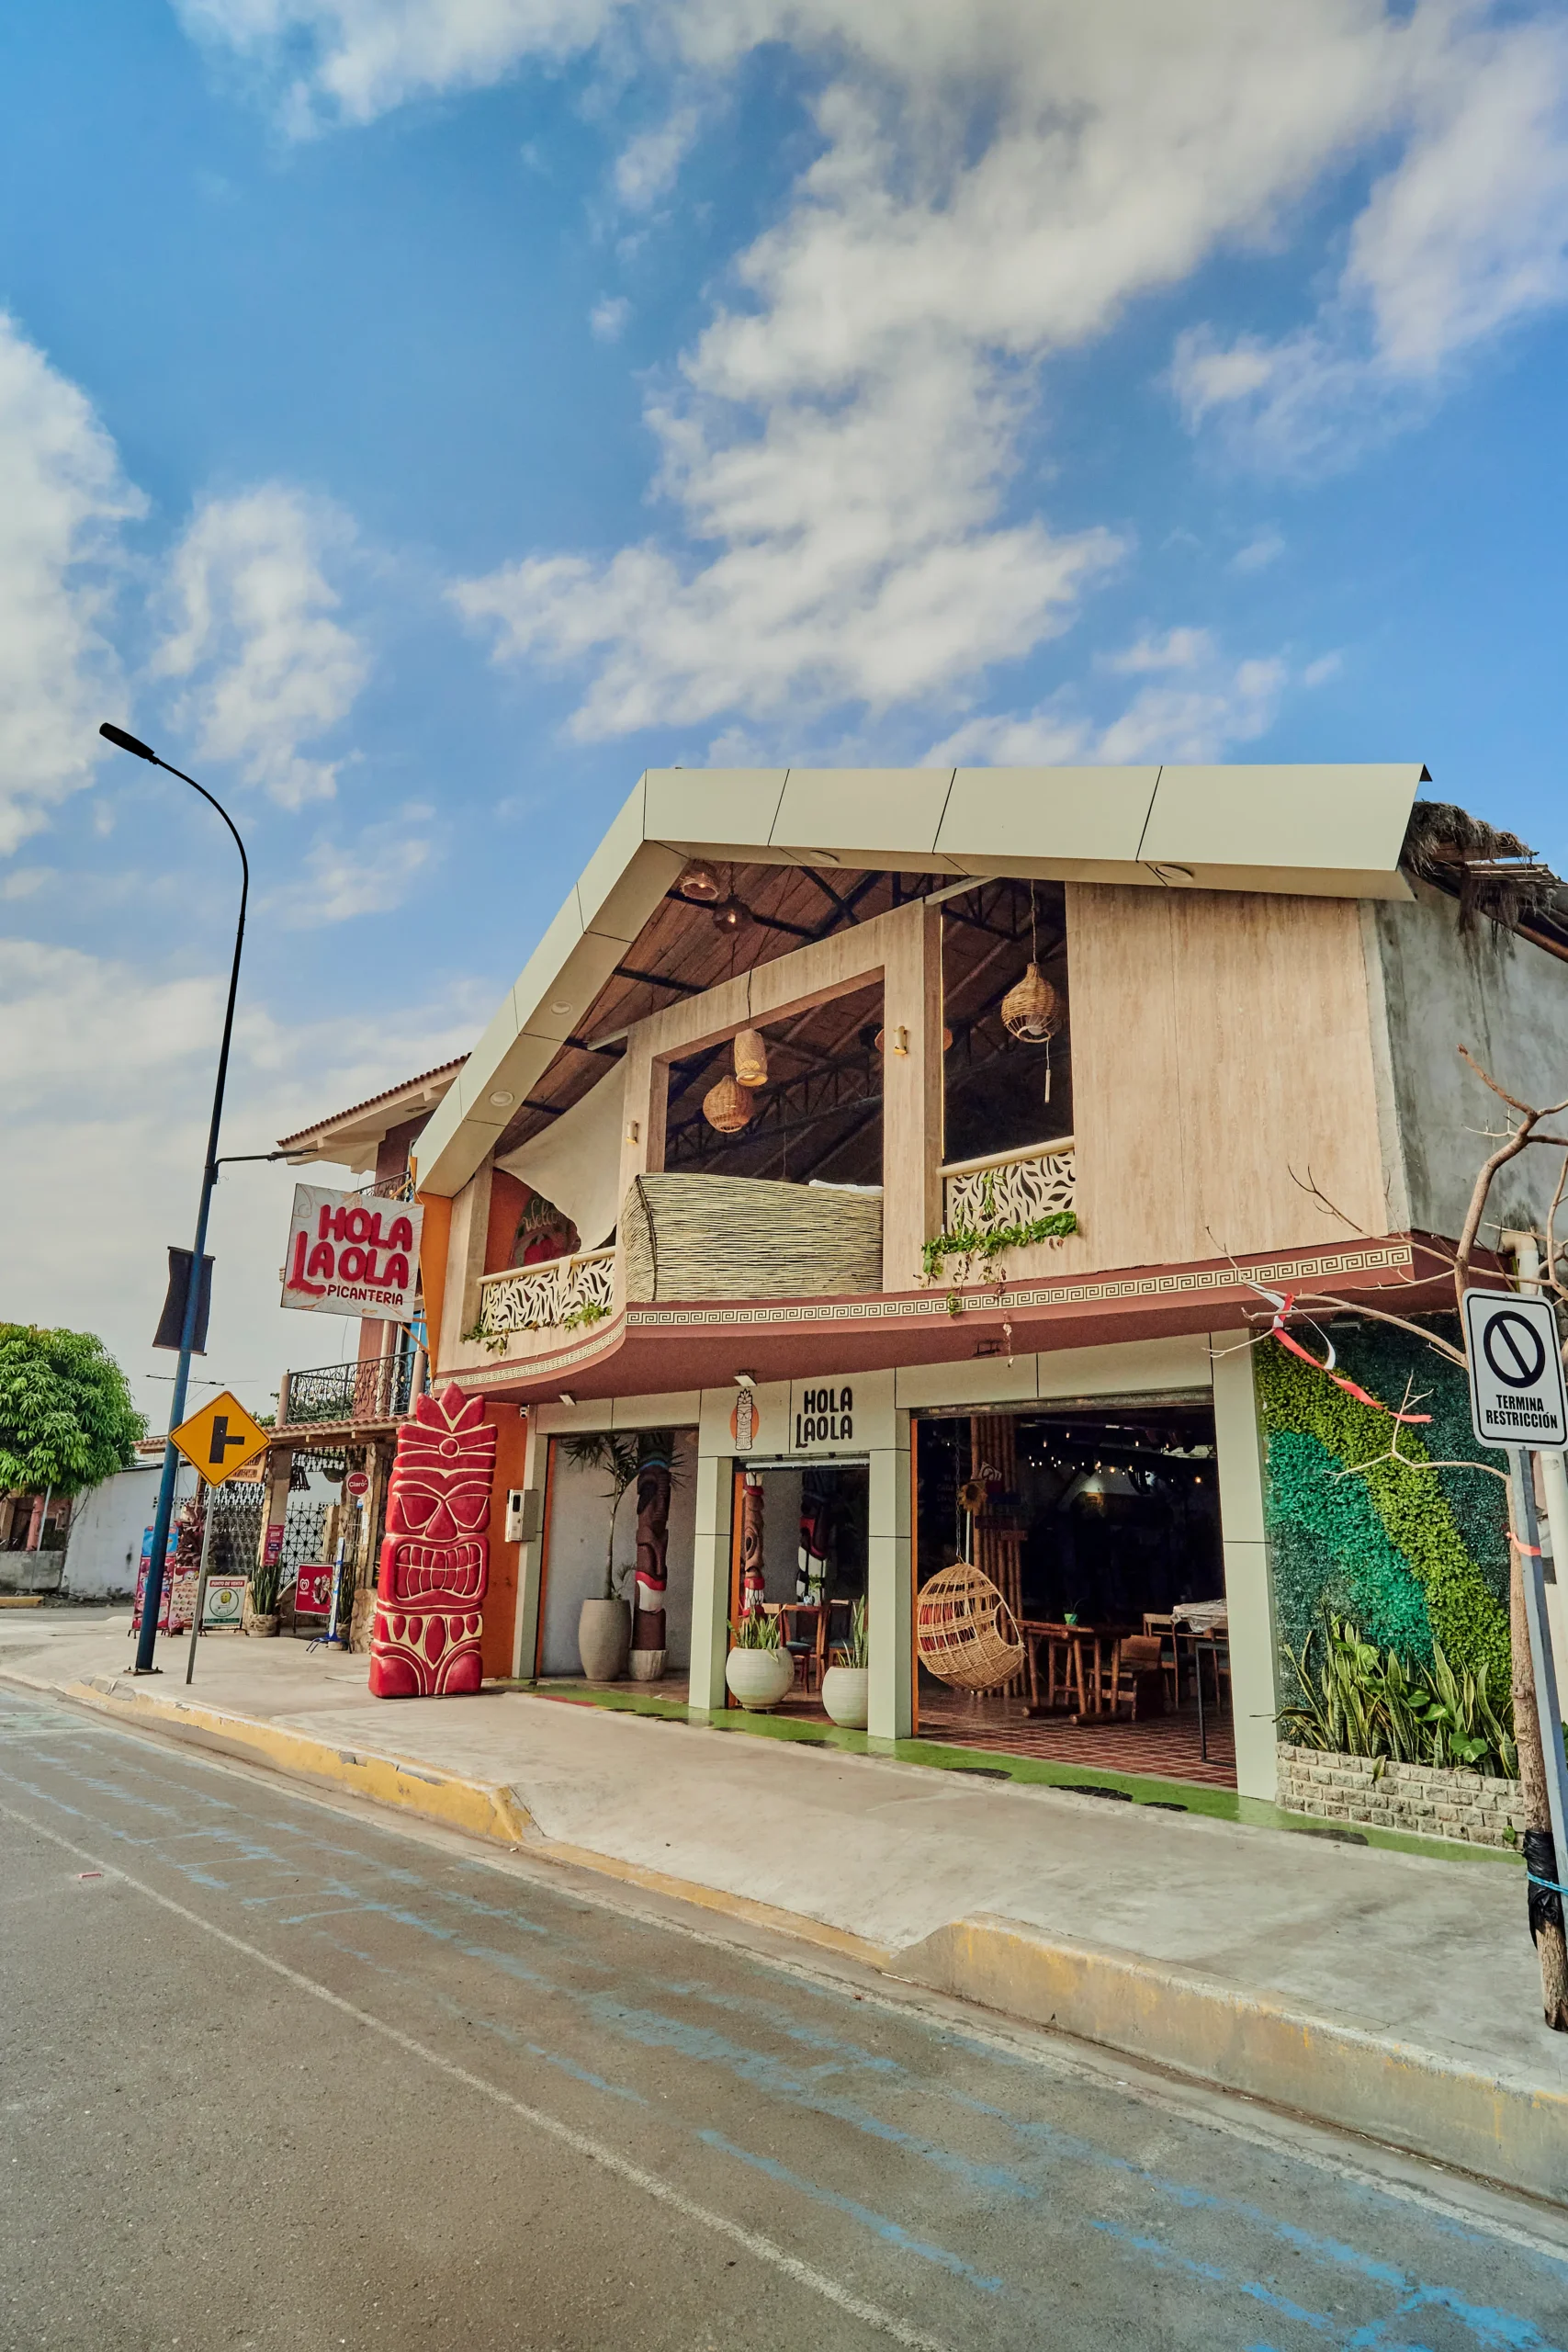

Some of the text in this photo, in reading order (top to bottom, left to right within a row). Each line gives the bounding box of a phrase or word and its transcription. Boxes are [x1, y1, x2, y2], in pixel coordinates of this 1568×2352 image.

[319, 1204, 412, 1252] HOLA
[327, 1284, 403, 1306] PICANTERIA
[804, 1386, 852, 1414] HOLA
[1495, 1394, 1544, 1412] TERMINA
[1485, 1409, 1558, 1429] RESTRICCIÓN
